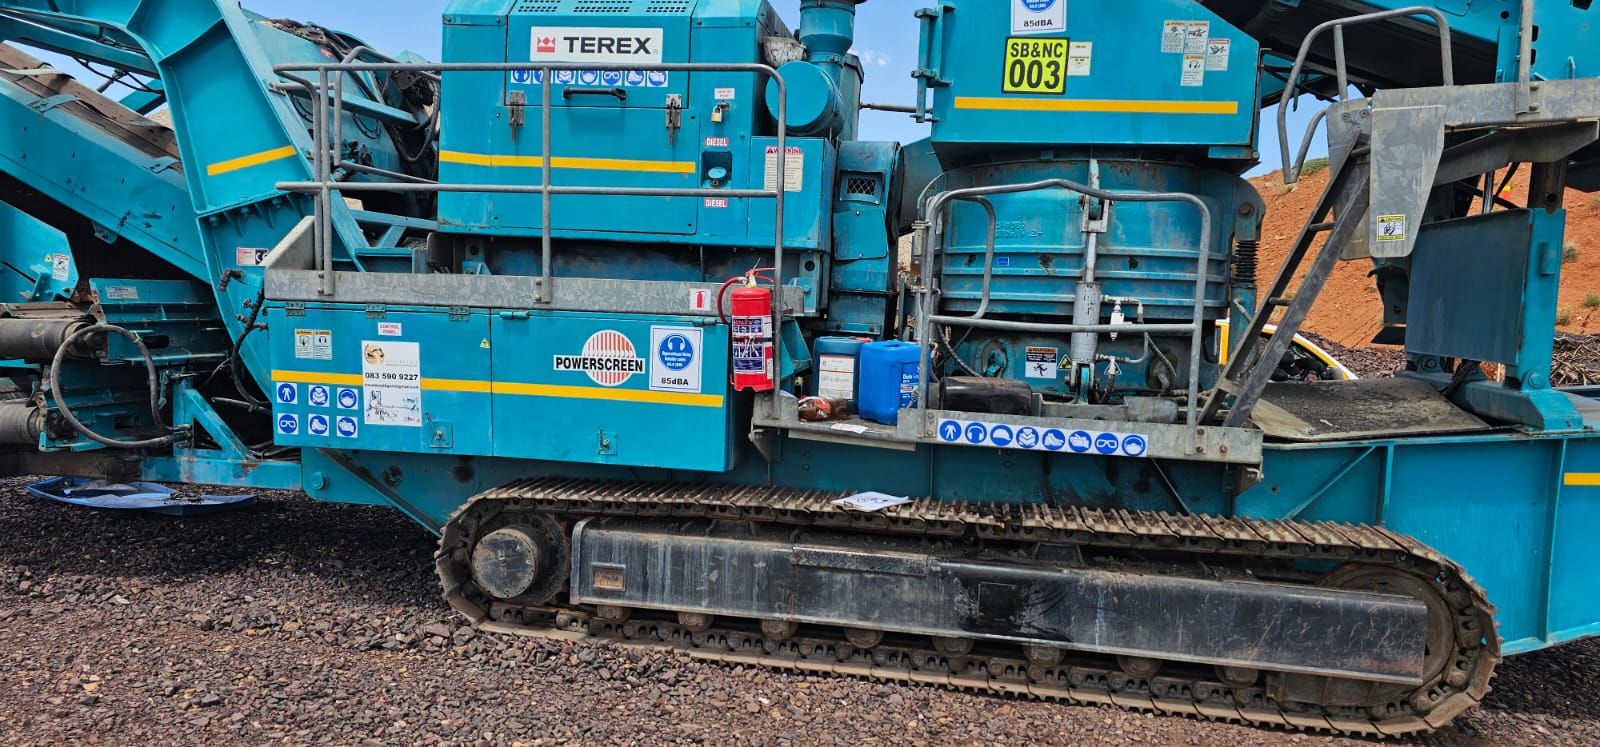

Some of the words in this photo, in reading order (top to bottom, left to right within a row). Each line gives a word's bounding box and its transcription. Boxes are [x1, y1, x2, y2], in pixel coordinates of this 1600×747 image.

[1023, 18, 1053, 27] 85dBA
[563, 36, 652, 55] TEREX
[1010, 42, 1064, 58] SB&NC
[1009, 59, 1061, 89] 003
[706, 137, 728, 147] DIESEL
[705, 199, 727, 208] DIESEL
[556, 356, 643, 373] POWERSCREEN
[365, 372, 380, 380] 083
[382, 372, 397, 380] 590
[398, 373, 419, 381] 9227
[661, 377, 689, 386] 85dBA
